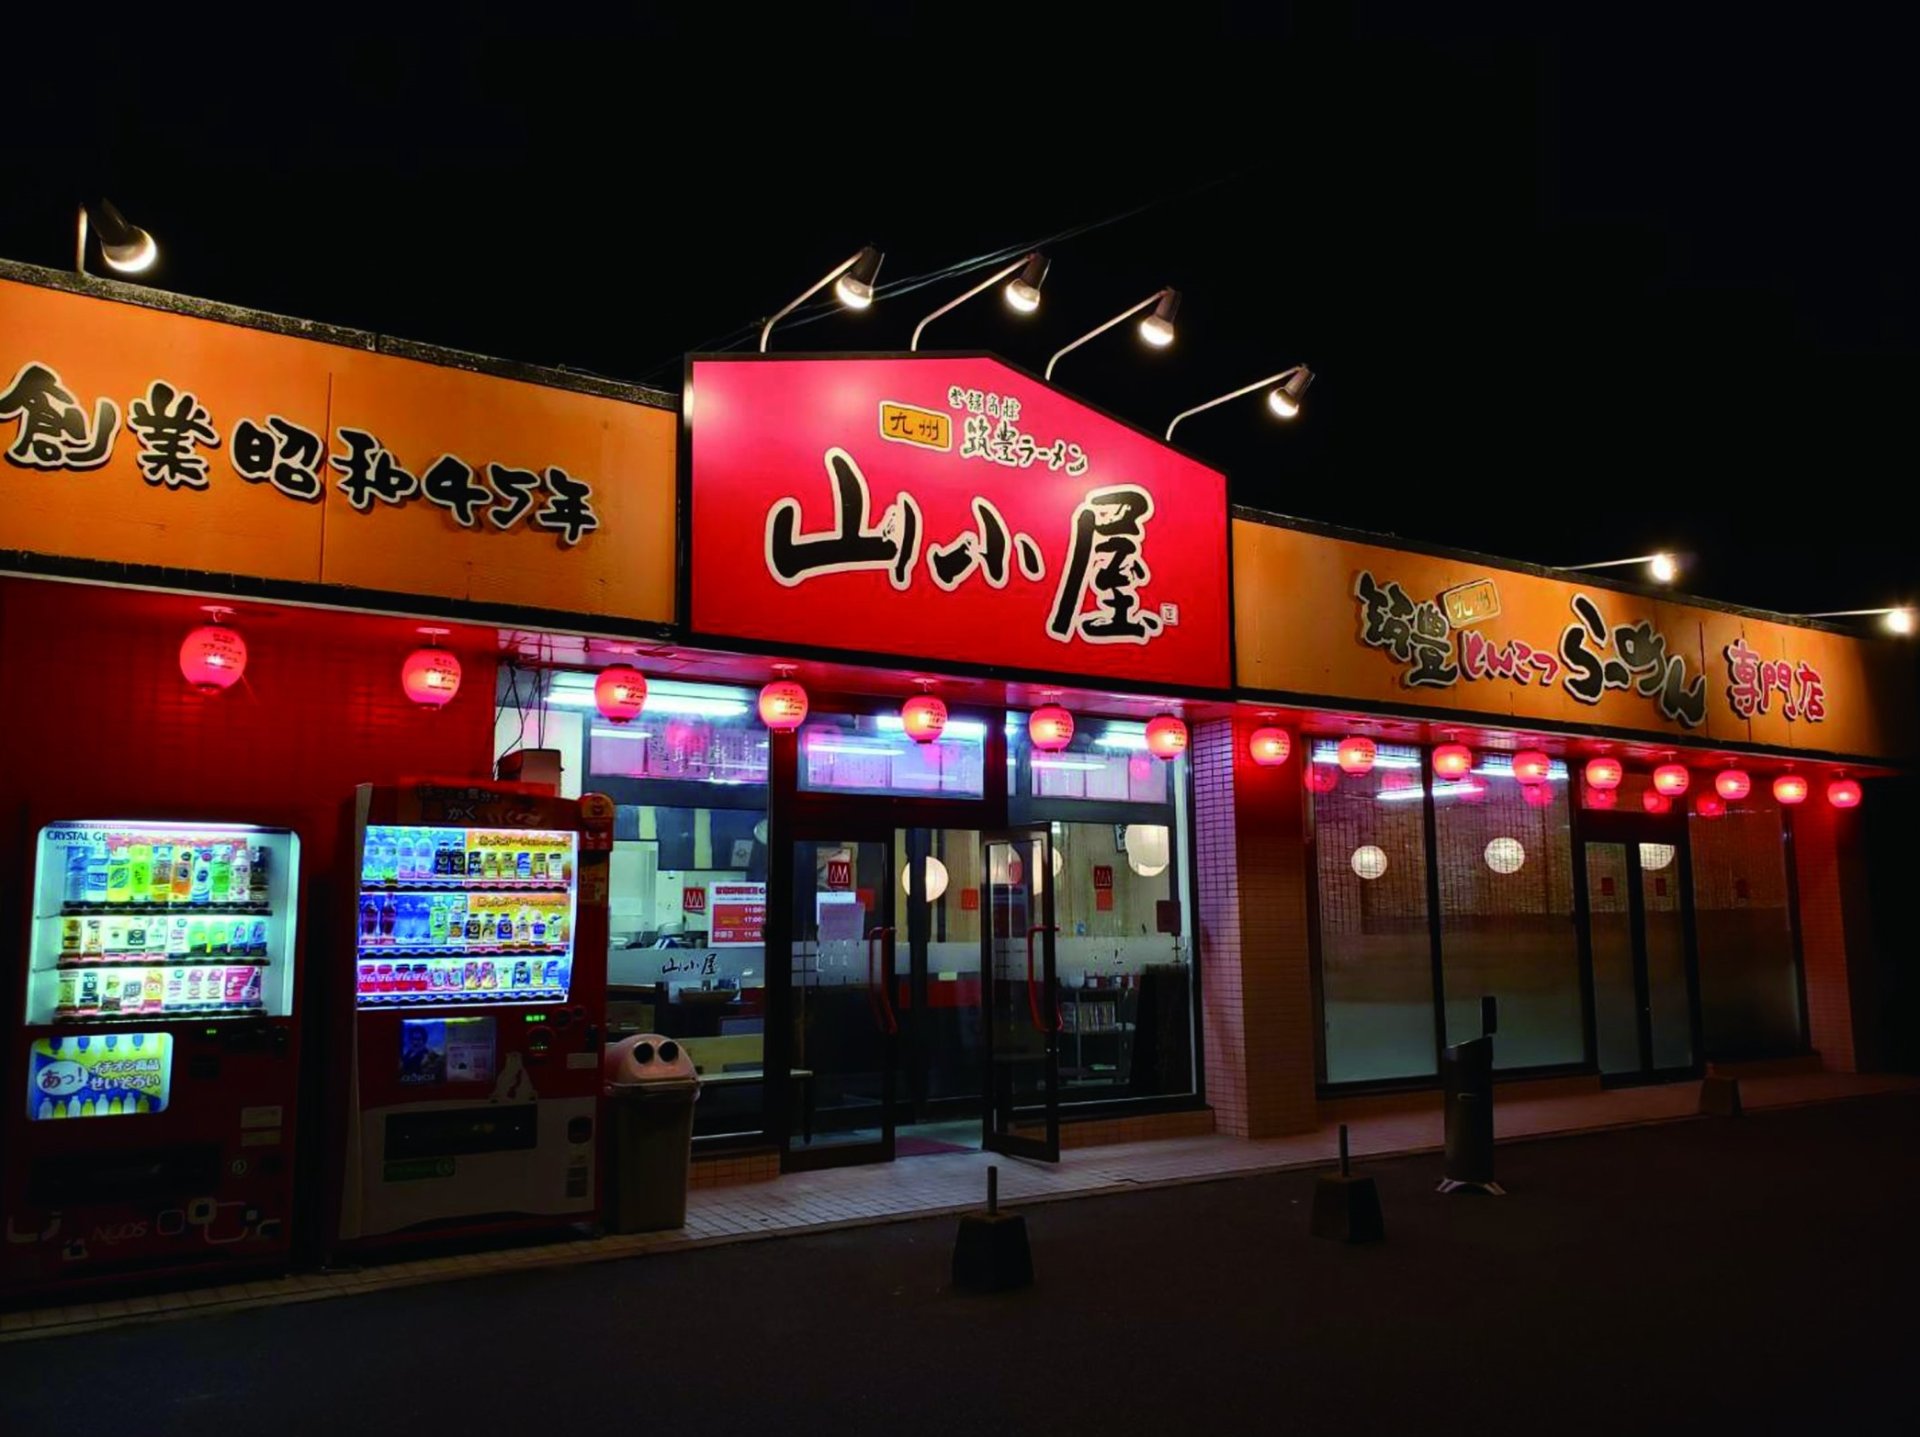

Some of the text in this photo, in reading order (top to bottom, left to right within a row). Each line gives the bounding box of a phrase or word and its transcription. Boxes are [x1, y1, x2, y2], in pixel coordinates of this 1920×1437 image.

[889, 412, 939, 441] 九州
[961, 417, 1087, 474] 筑豊ラーメン
[766, 450, 1164, 642] 山小屋
[1560, 593, 1707, 727] らーめん
[1727, 639, 1826, 720] 専門店
[46, 830, 88, 841] CRYSTAL
[662, 953, 717, 975] 山小屋
